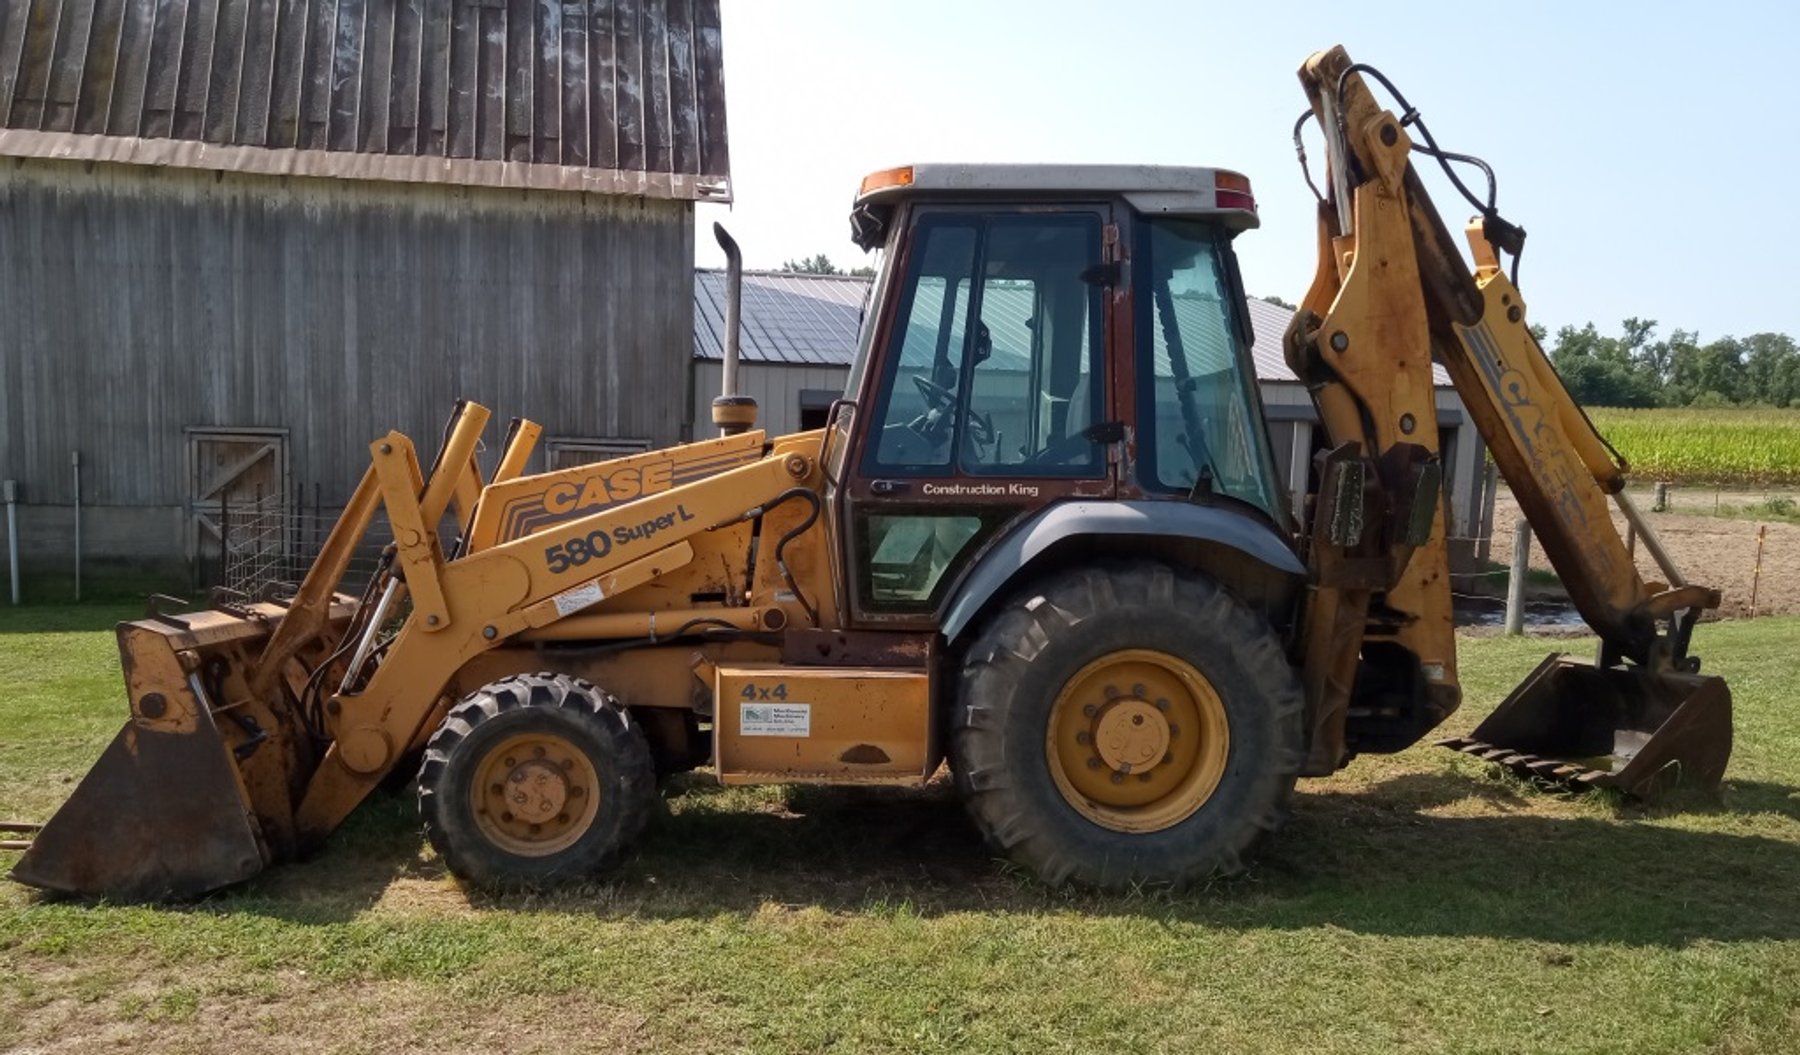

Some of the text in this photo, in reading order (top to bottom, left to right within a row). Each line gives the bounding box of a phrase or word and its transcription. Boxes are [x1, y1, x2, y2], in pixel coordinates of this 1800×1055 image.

[543, 459, 674, 514] CASE
[922, 483, 1039, 497] Construction King
[545, 504, 695, 574] 580 Super L
[741, 683, 788, 700] 4x4
